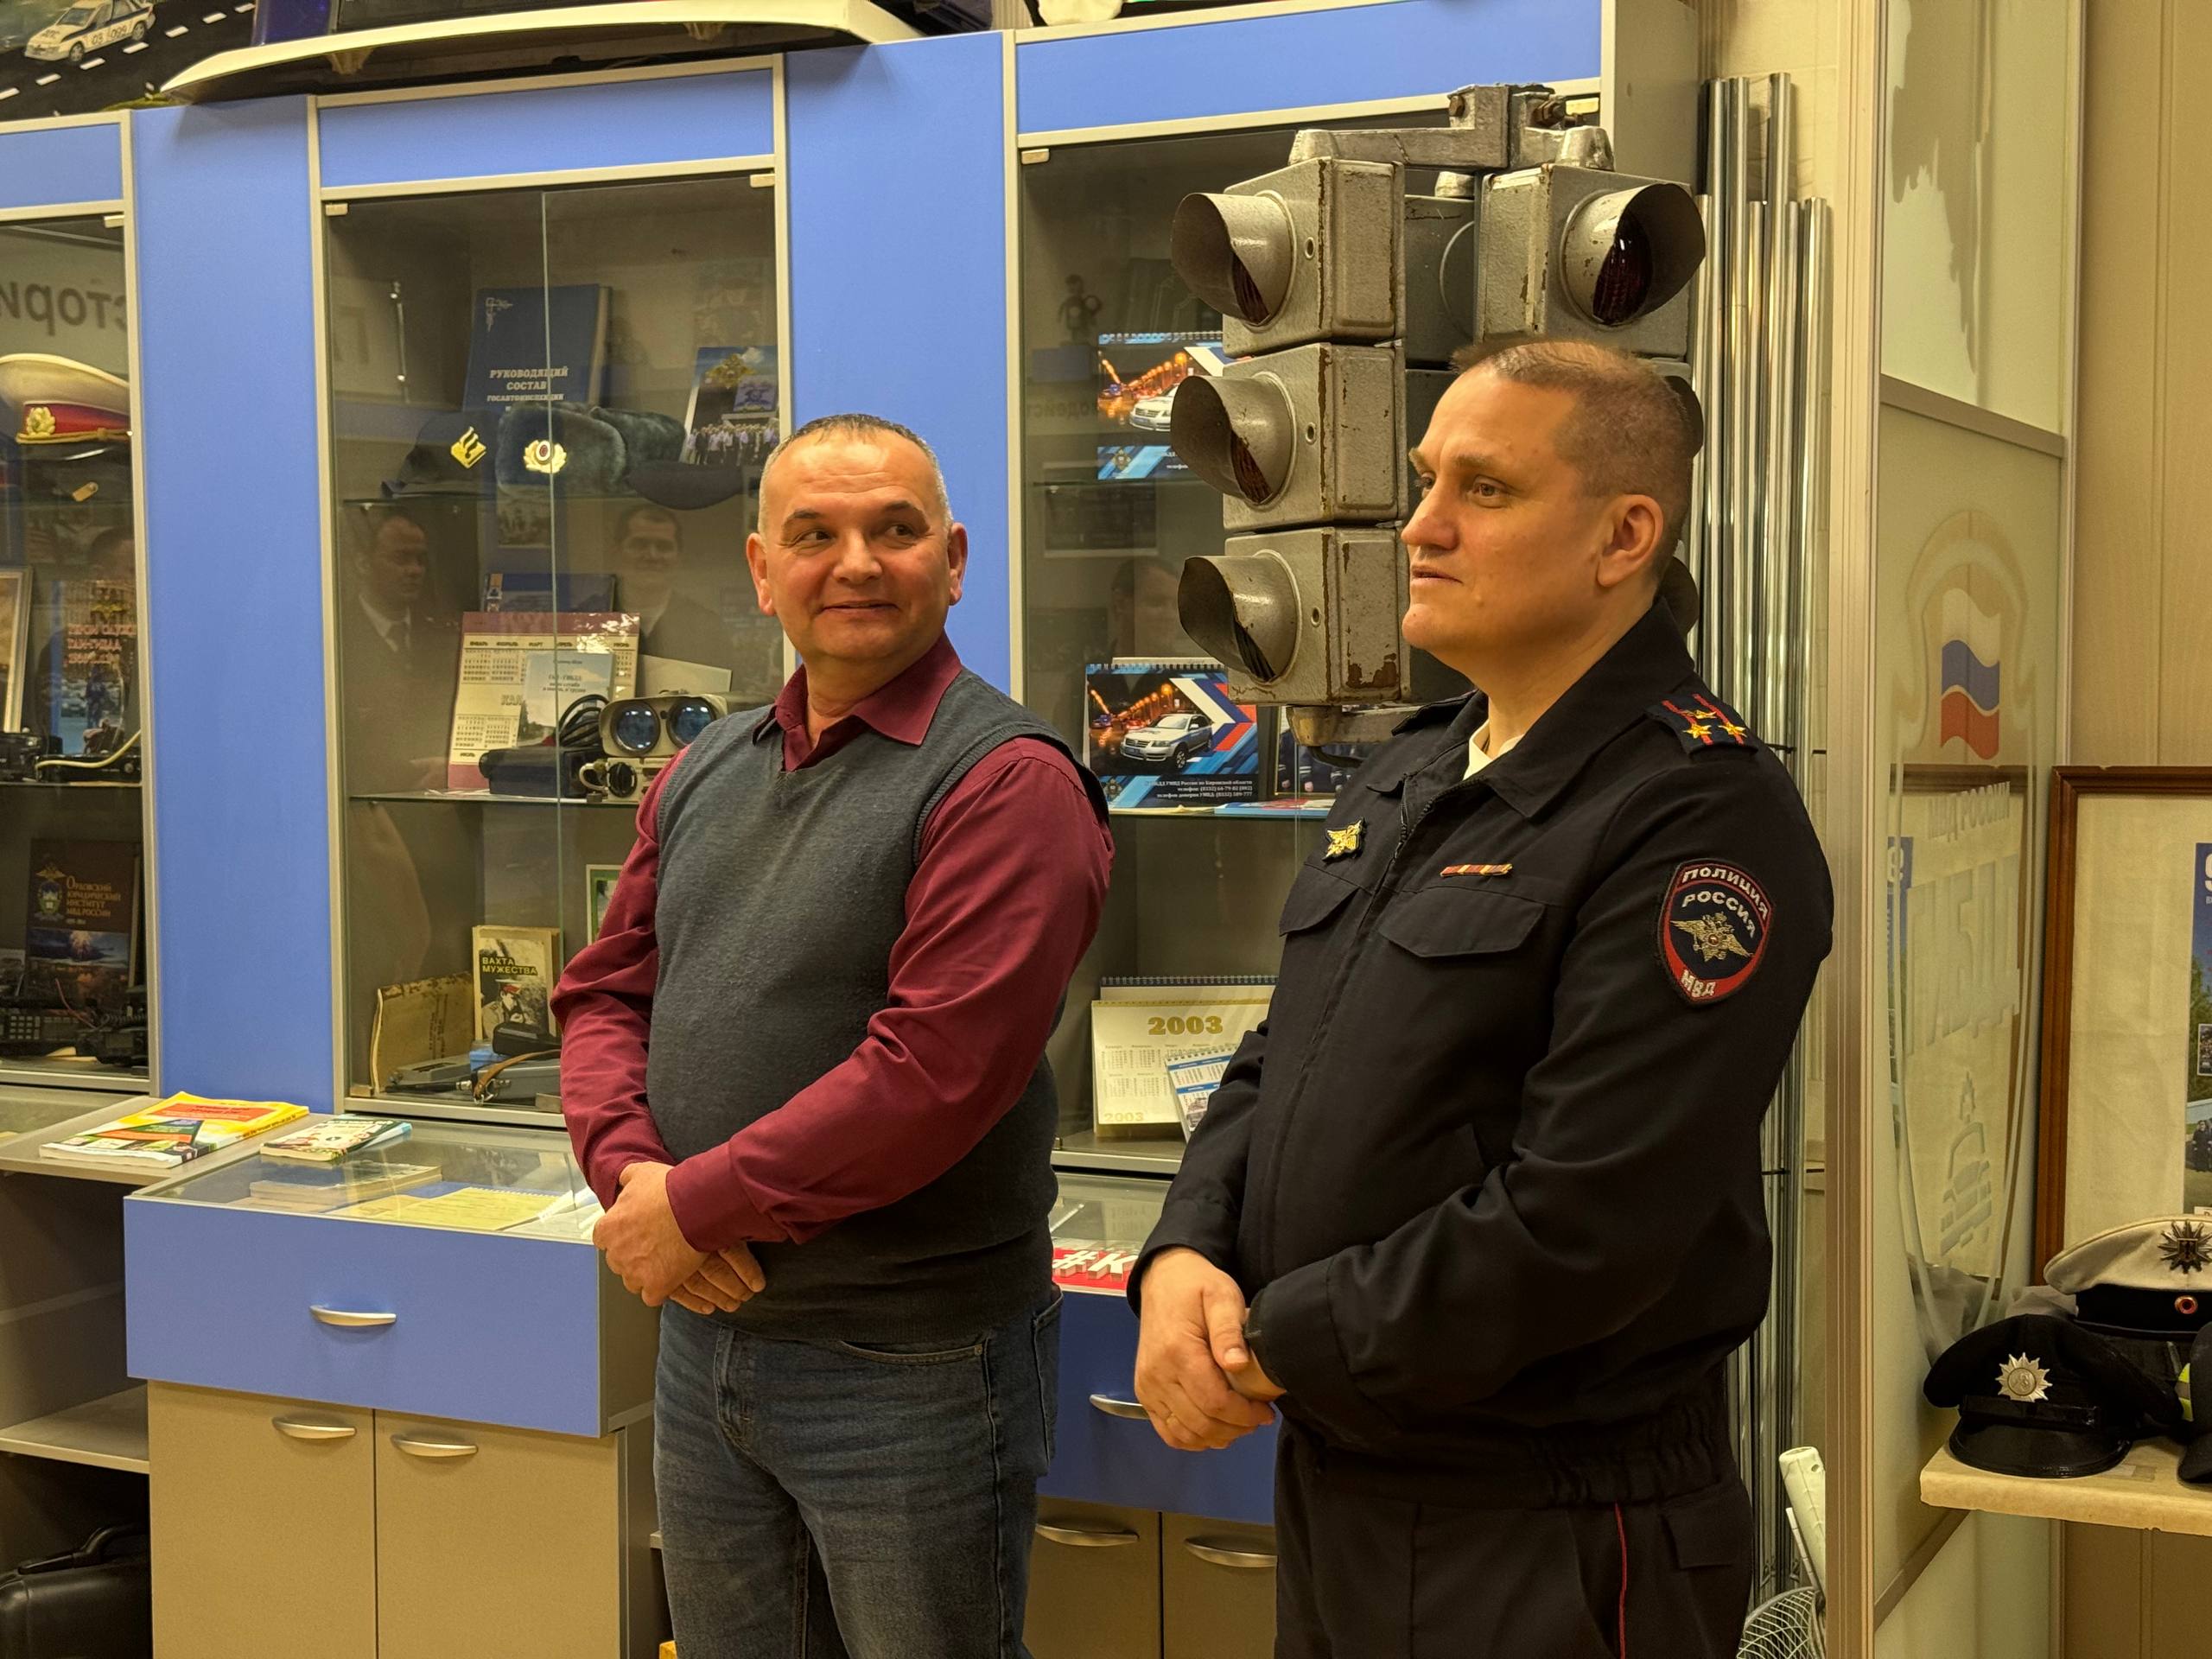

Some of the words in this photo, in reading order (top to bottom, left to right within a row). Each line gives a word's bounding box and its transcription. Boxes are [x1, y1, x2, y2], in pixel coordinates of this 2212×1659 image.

[506, 381, 547, 390] СОСТАВ
[1682, 867, 1769, 920] ПОЛИЦИЯ
[1681, 891, 1755, 938] РОССИЯ
[482, 957, 514, 966] ВАХТА
[482, 965, 537, 975] МУЖЕСТВА
[1680, 969, 1717, 998] МВД
[1147, 1015, 1223, 1035] 2003
[1104, 1111, 1144, 1122] 2003
